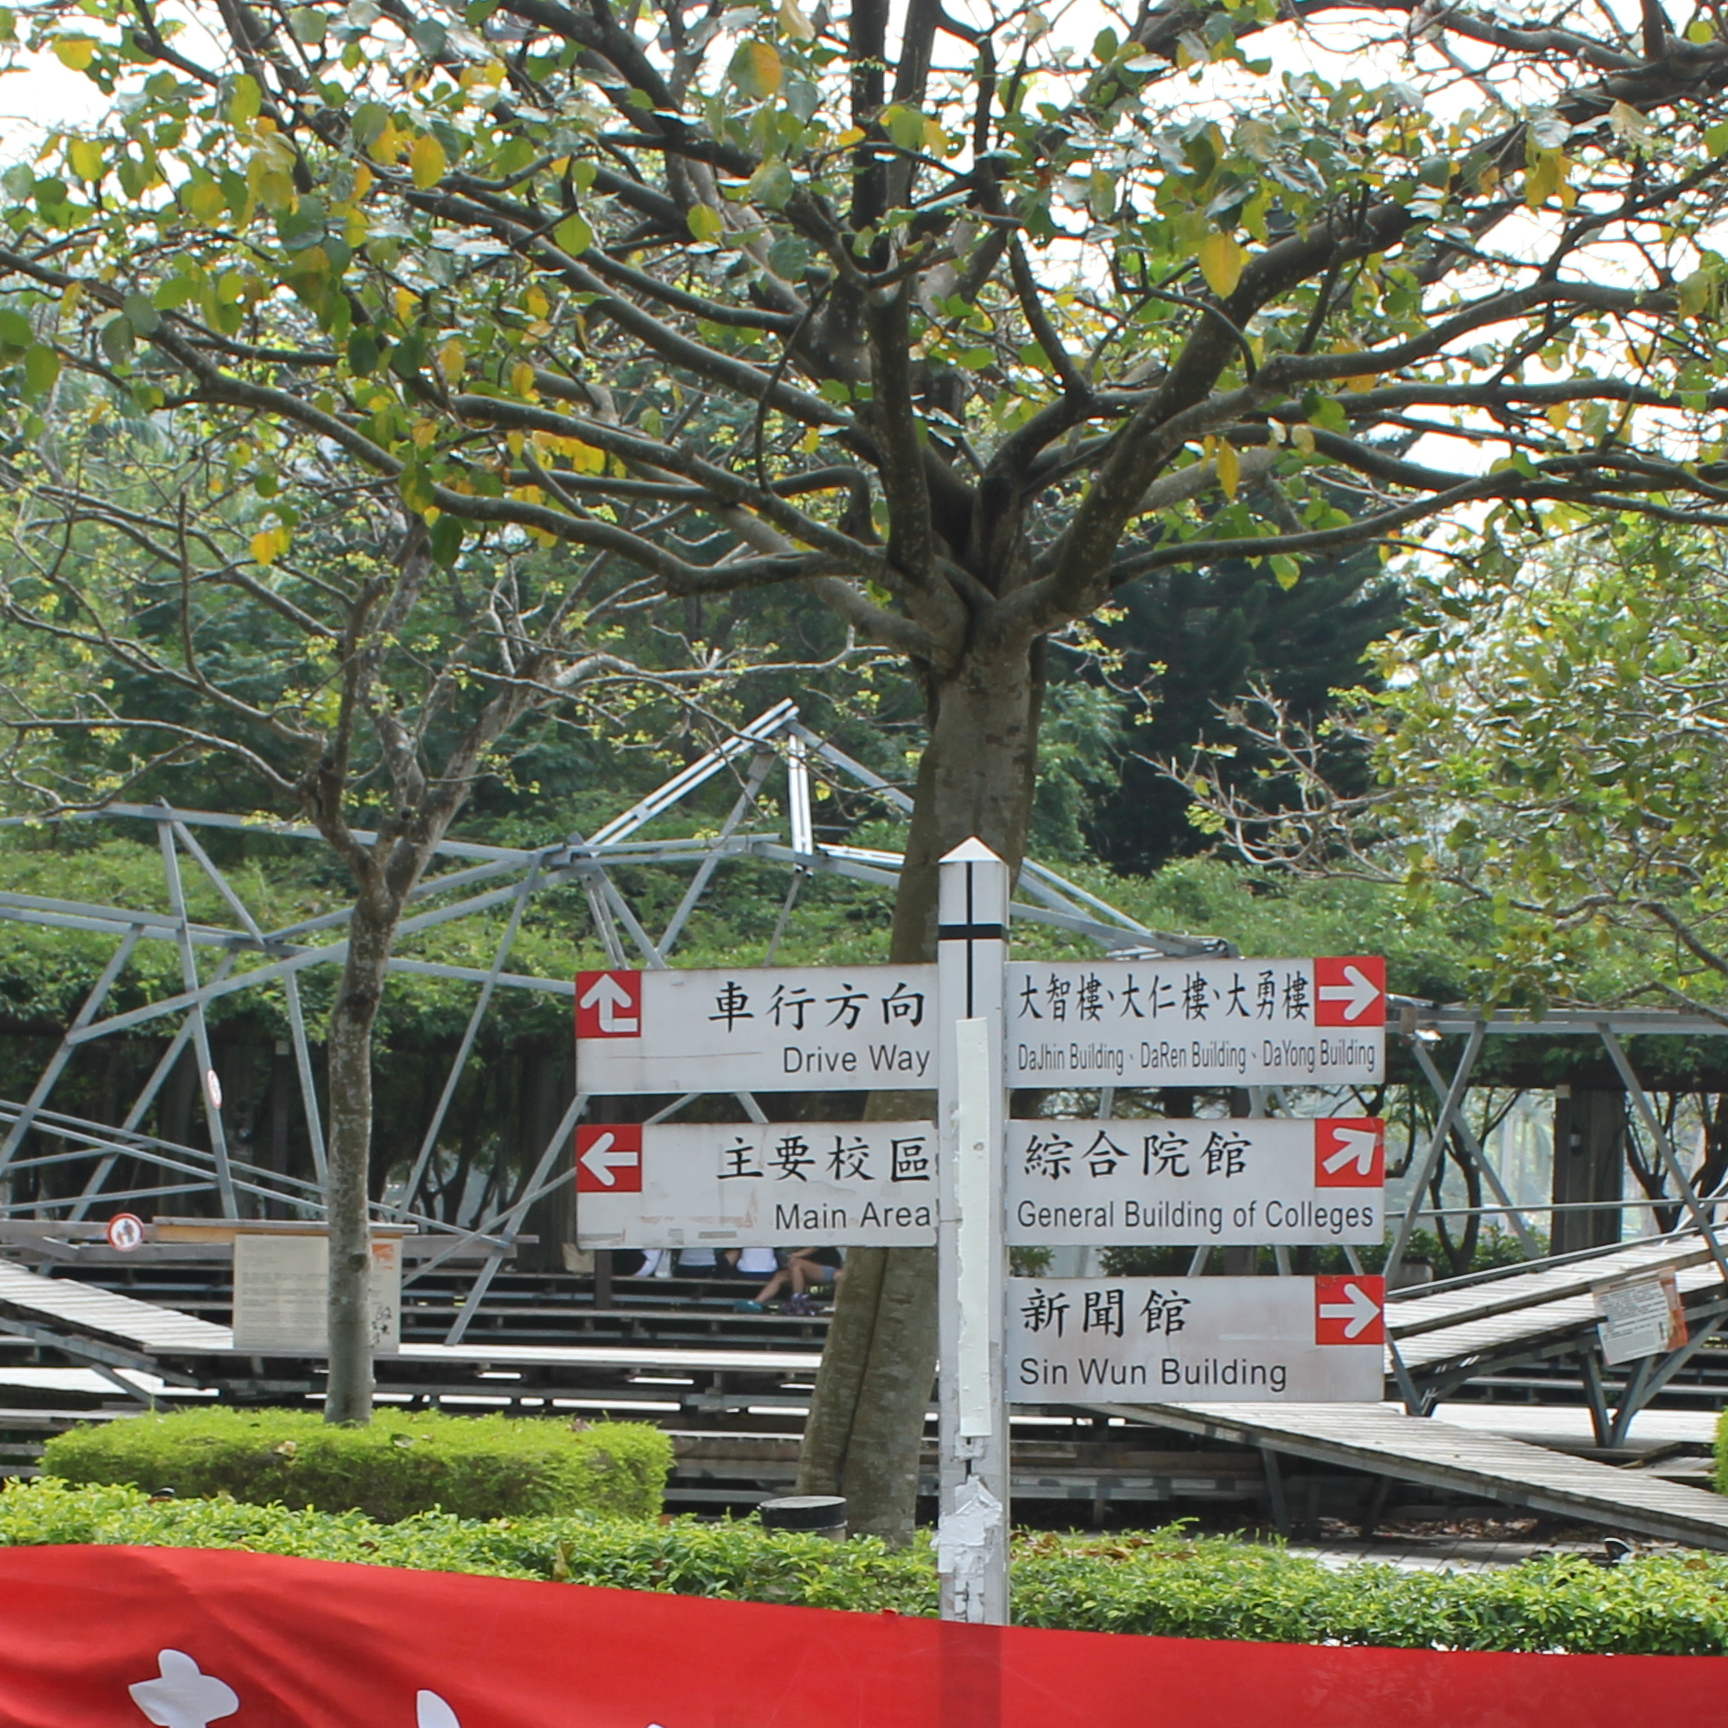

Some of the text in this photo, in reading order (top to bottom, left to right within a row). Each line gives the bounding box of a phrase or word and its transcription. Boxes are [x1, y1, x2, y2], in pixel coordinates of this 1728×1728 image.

[708, 980, 925, 1033] 車行方向
[783, 1044, 930, 1077] Drive Way
[1017, 1043, 1066, 1071] DaJhin
[1140, 1041, 1188, 1069] DaRen
[1262, 1039, 1316, 1074] DaYong
[1319, 1037, 1376, 1073] Building
[716, 1135, 931, 1182] 主要校區
[1023, 1129, 1253, 1179] 綜合院館
[775, 1201, 931, 1230] Main Area
[1016, 1199, 1374, 1235] General Building of Colleges
[1020, 1287, 1192, 1339] 新聞館
[1019, 1357, 1287, 1393] Sin Wun Building
